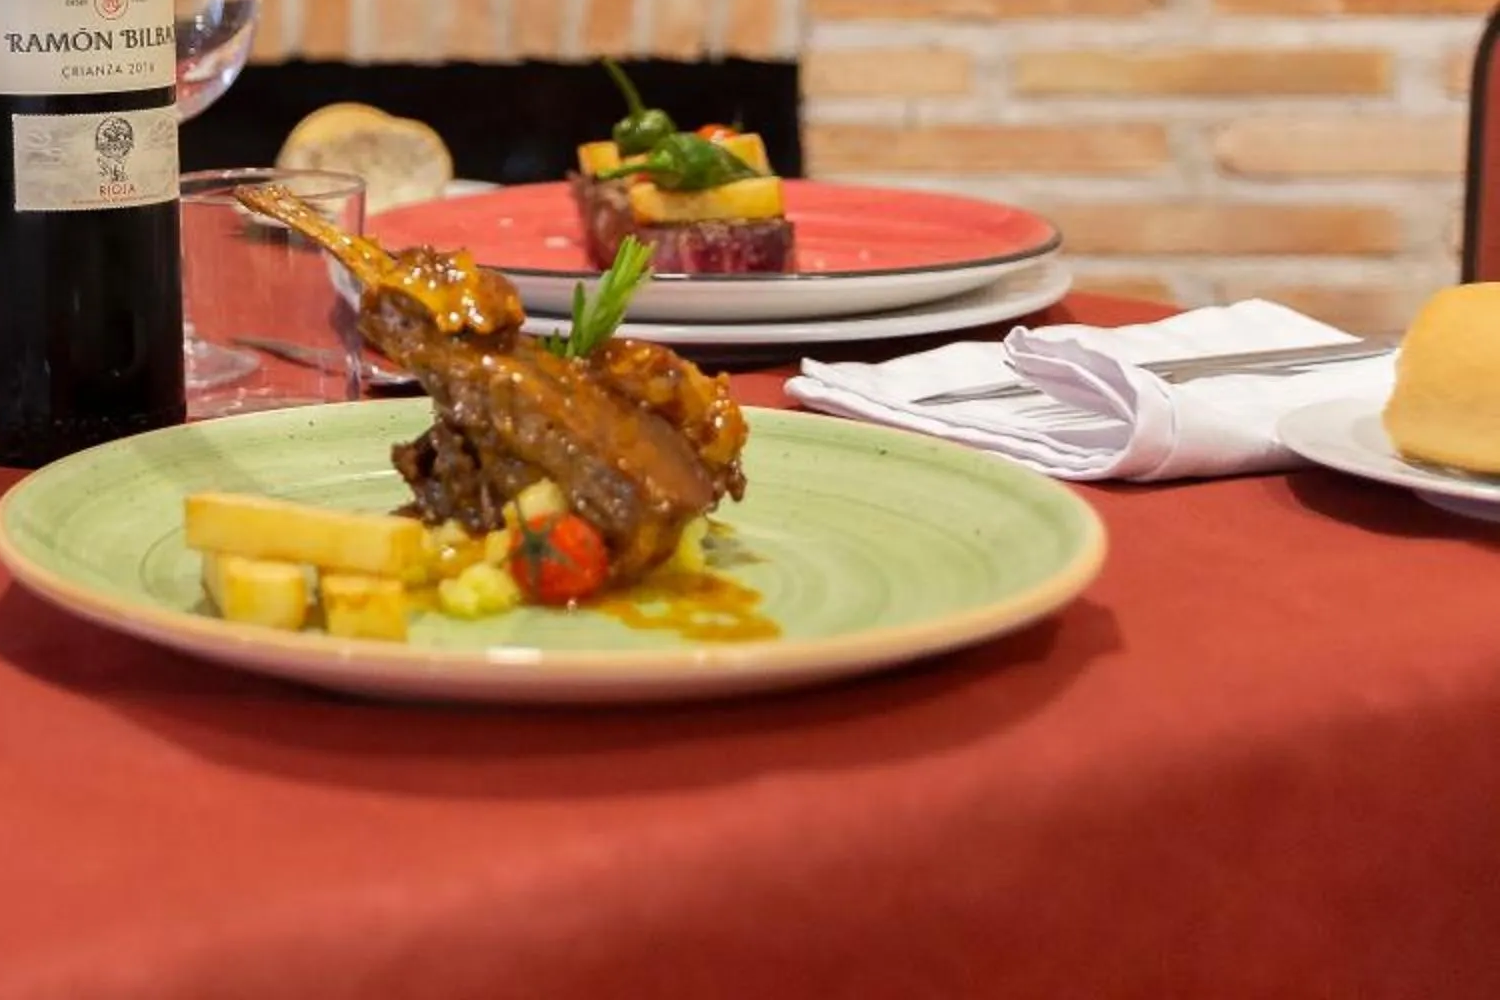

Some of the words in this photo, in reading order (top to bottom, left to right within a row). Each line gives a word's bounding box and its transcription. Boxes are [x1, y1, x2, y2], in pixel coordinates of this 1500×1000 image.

[119, 23, 176, 49] BILBA
[61, 63, 123, 78] CRIANZA
[100, 184, 136, 197] RIOJA
